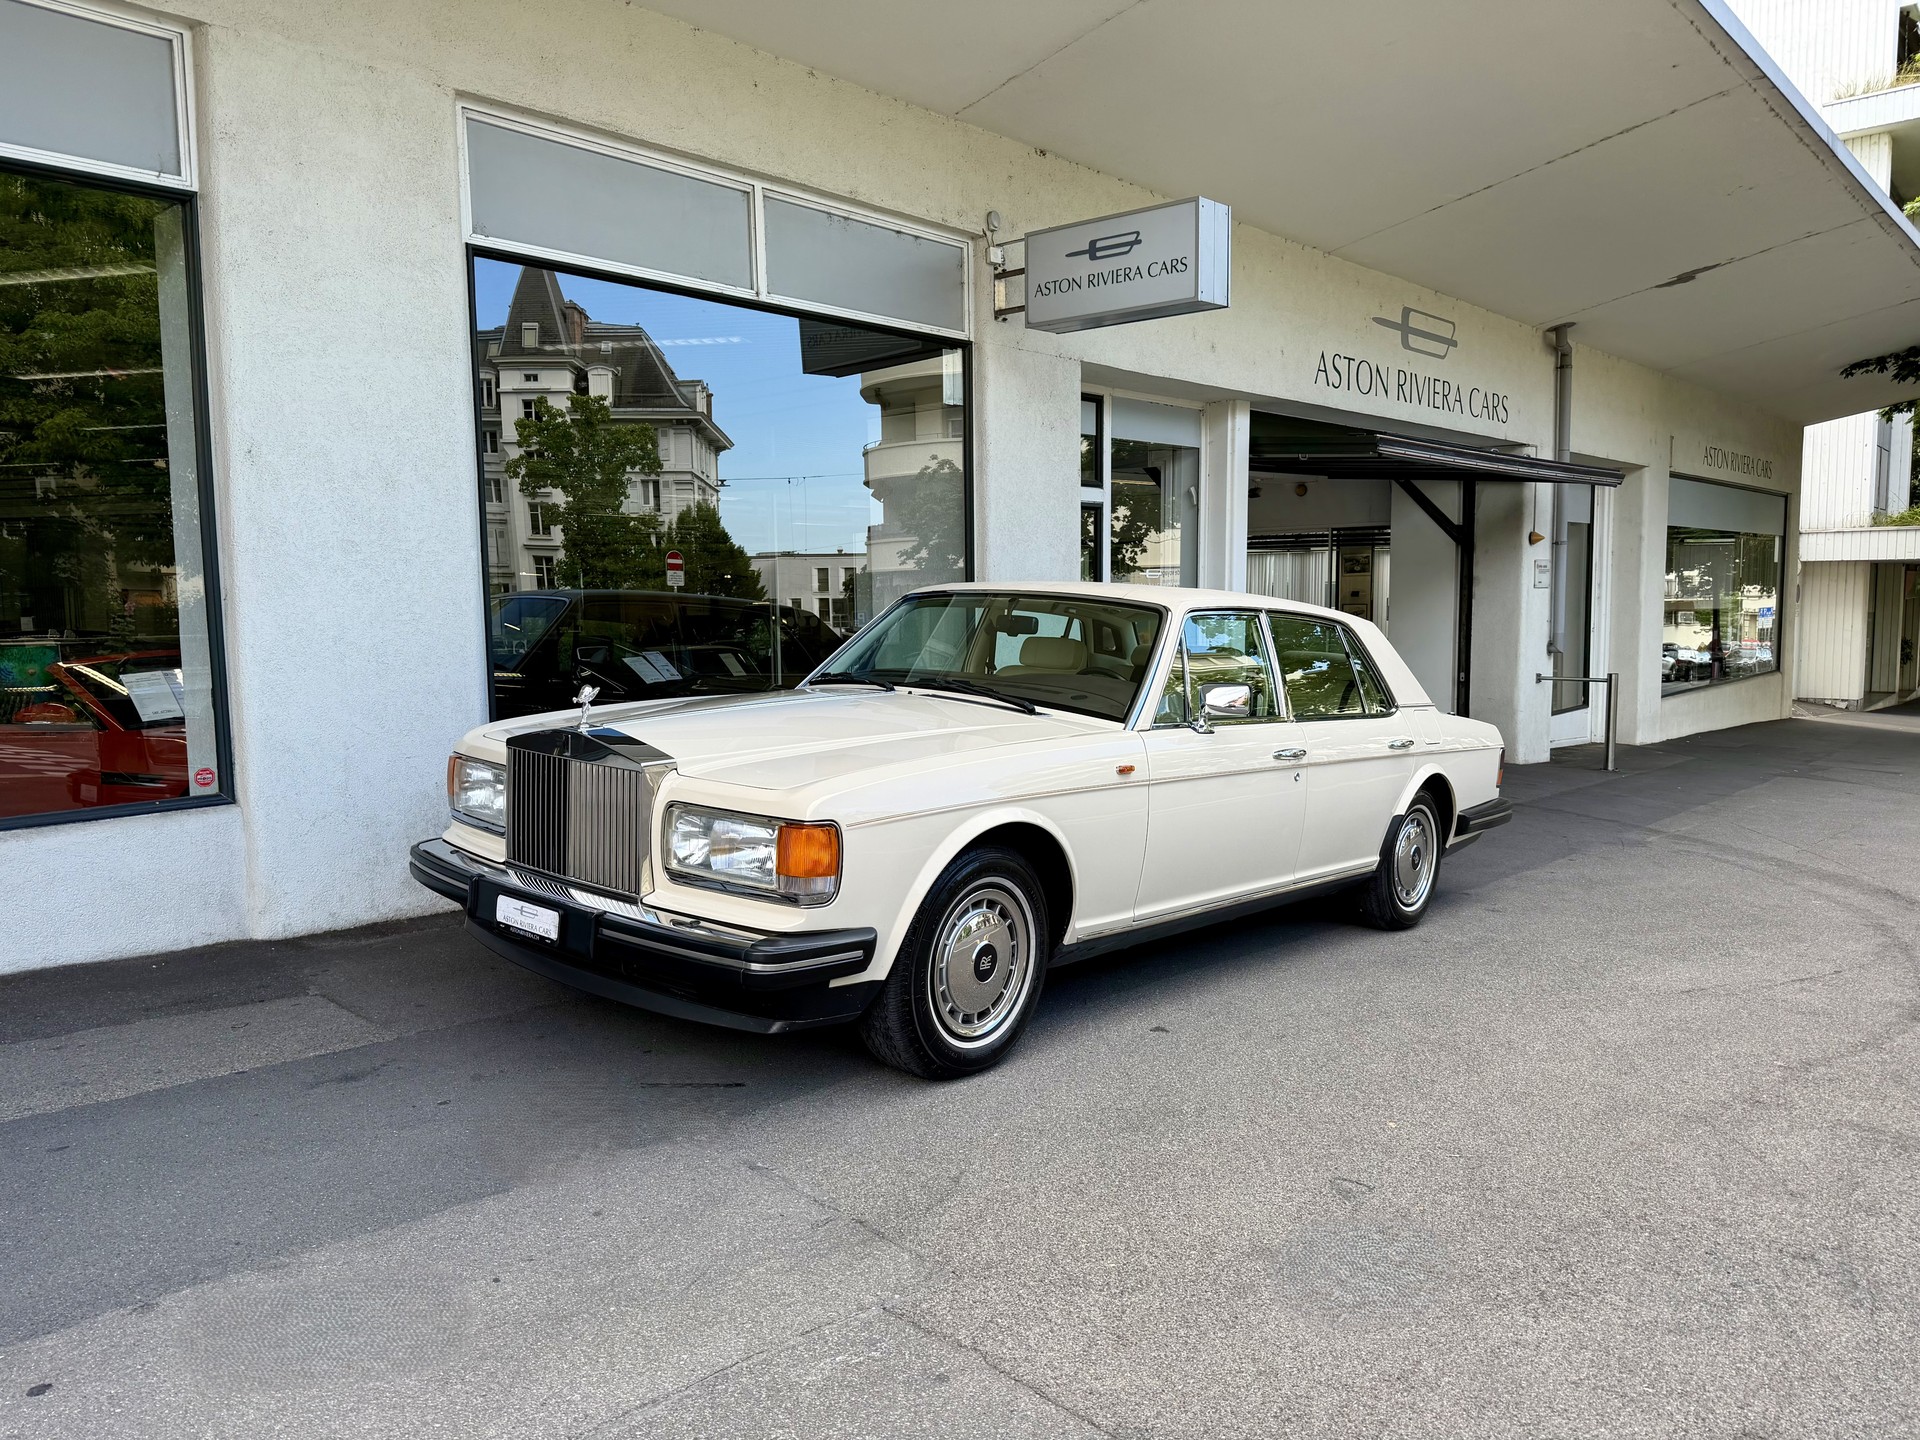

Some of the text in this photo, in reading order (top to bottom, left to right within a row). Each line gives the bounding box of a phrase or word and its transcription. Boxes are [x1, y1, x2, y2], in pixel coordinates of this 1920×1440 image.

[1034, 256, 1188, 298] ASTON RIVIERA CARS
[1314, 350, 1509, 424] ASTON RIVIERA CARS
[1703, 445, 1773, 479] ASTON RIVIERA CARS
[503, 915, 552, 937] ASTON RIVIERA CARS
